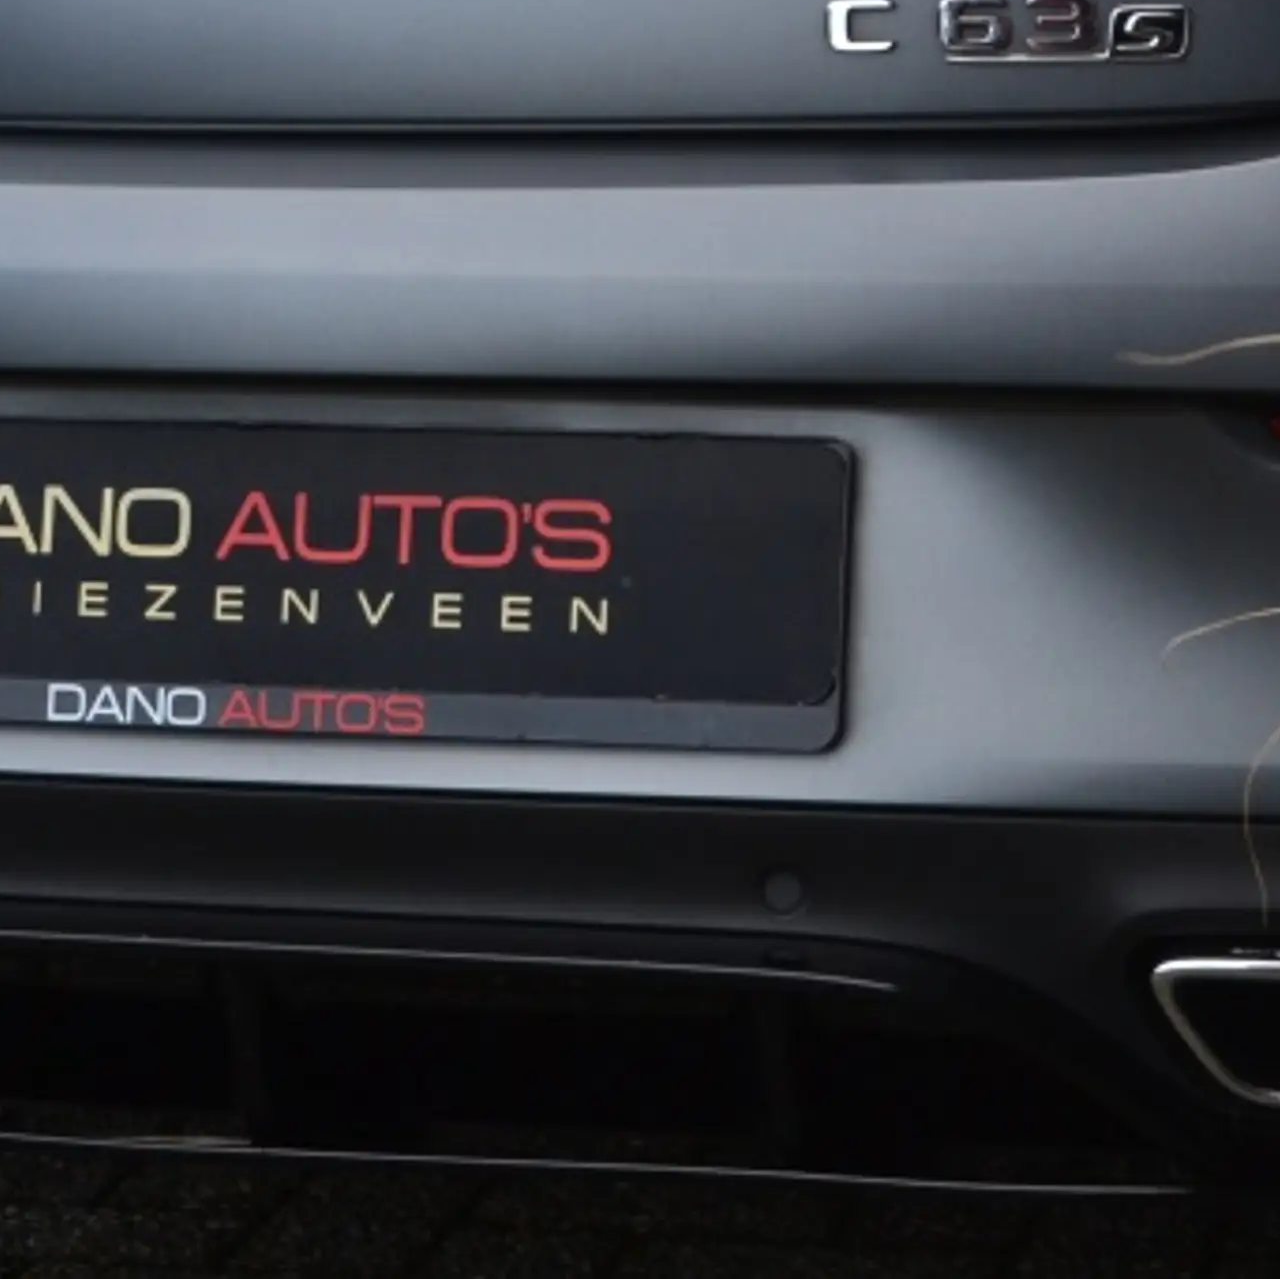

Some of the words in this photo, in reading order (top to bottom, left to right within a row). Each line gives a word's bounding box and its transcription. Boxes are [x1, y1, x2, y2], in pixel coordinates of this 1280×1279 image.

[215, 490, 613, 572] AUTO'S
[45, 682, 208, 727] DANO
[217, 688, 426, 737] AUTO'S
